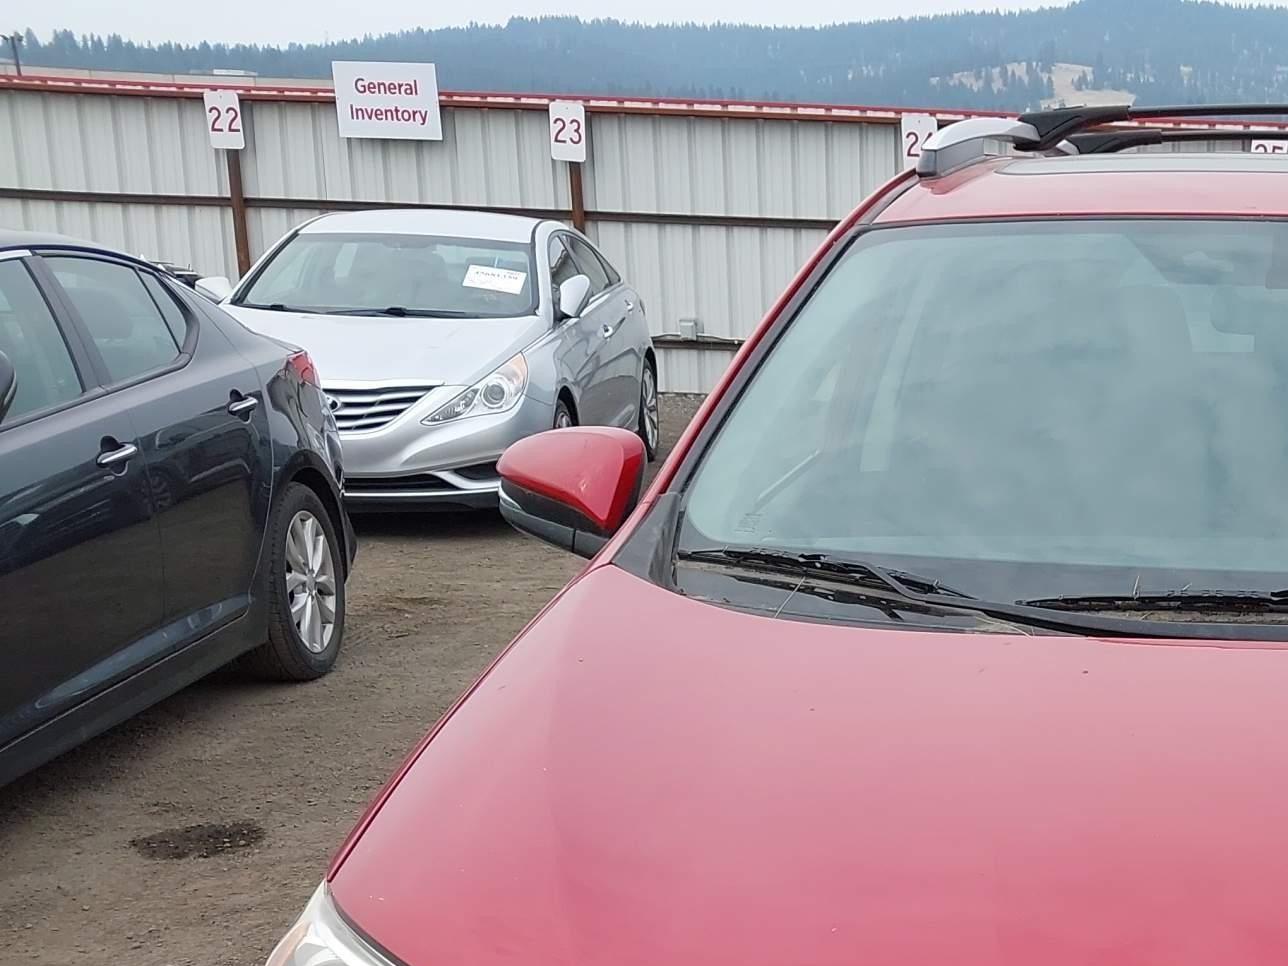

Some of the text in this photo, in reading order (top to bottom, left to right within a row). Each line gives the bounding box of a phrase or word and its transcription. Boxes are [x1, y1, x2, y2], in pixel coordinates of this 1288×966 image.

[354, 77, 418, 96] General
[208, 105, 241, 133] 22
[350, 104, 428, 126] Inventory
[553, 117, 582, 145] 23
